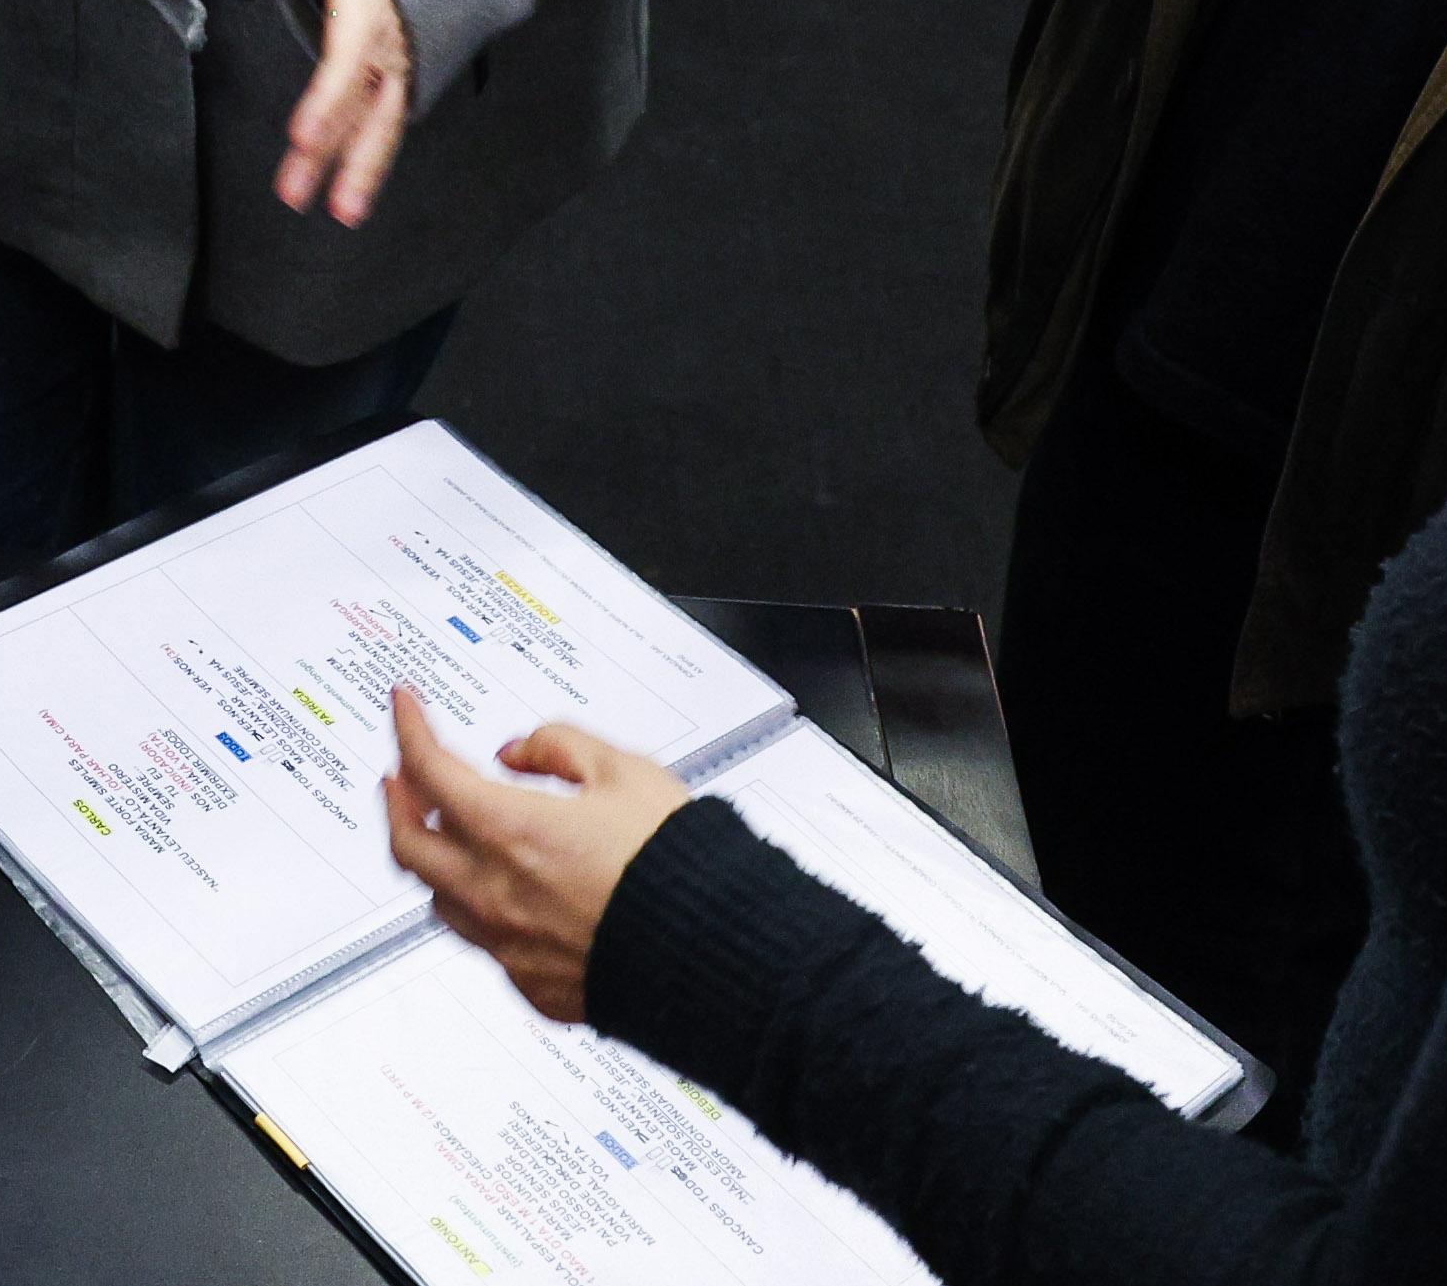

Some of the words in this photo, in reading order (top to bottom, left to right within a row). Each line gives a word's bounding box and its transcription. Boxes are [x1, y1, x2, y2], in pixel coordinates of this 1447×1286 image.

[446, 558, 480, 584] JESUS
[457, 553, 499, 585] SEMPRE
[457, 582, 507, 622] LEVANTAR
[493, 584, 550, 629] CONTINUAR
[404, 637, 439, 664] VOLTA
[521, 621, 557, 648] ESTOU
[545, 628, 577, 652] AMOR
[325, 656, 359, 685] JOVEM
[346, 630, 405, 679] ENCONTRAR
[372, 638, 410, 669] VER-ME
[423, 639, 464, 672] SEMPRE
[220, 670, 253, 698] JESUS
[231, 665, 271, 699] SEMPRE
[345, 660, 390, 697] ANSIOSA
[459, 671, 489, 694] FELIZ
[355, 684, 389, 712] MARIA
[447, 689, 476, 712] DEUS
[36, 708, 67, 734] CIMA)
[230, 695, 279, 738] LEVANTAR
[266, 698, 323, 747] CONTINUAR
[61, 734, 90, 759] PARA
[145, 731, 182, 763] VOLTA)
[293, 738, 328, 768] ESTOU
[318, 746, 350, 772] AMOR
[67, 758, 108, 795] SIMPLES
[136, 739, 195, 793] (INDICADOR)
[145, 766, 163, 780] EU
[163, 783, 180, 797] TU
[199, 784, 229, 809] DEUS
[70, 797, 113, 836] CARLOS
[103, 794, 137, 825] FORTE
[147, 802, 173, 825] VIDA
[132, 824, 165, 854] MARIA
[592, 1053, 631, 1088] JESUS
[603, 1045, 652, 1089] SEMPRE
[606, 1084, 665, 1140] LEVANTAR
[648, 1087, 714, 1149] CONTINUAR
[495, 1127, 562, 1190] IGUALDADE
[570, 1144, 612, 1182] VOLTA
[680, 1138, 722, 1176] ESTOU
[709, 1147, 747, 1181] AMOR
[491, 1162, 540, 1207] JUNTOS
[502, 1153, 552, 1200] SENHOR
[582, 1176, 621, 1210] IGUAL
[534, 1204, 575, 1242] MARIA
[546, 1198, 588, 1235] JESUS
[555, 1187, 600, 1228] NOSSO
[576, 1189, 634, 1242] VONTADE
[493, 1204, 557, 1263] ESPALHAR
[594, 1226, 619, 1247] PAI
[615, 1208, 657, 1246] MARIA
